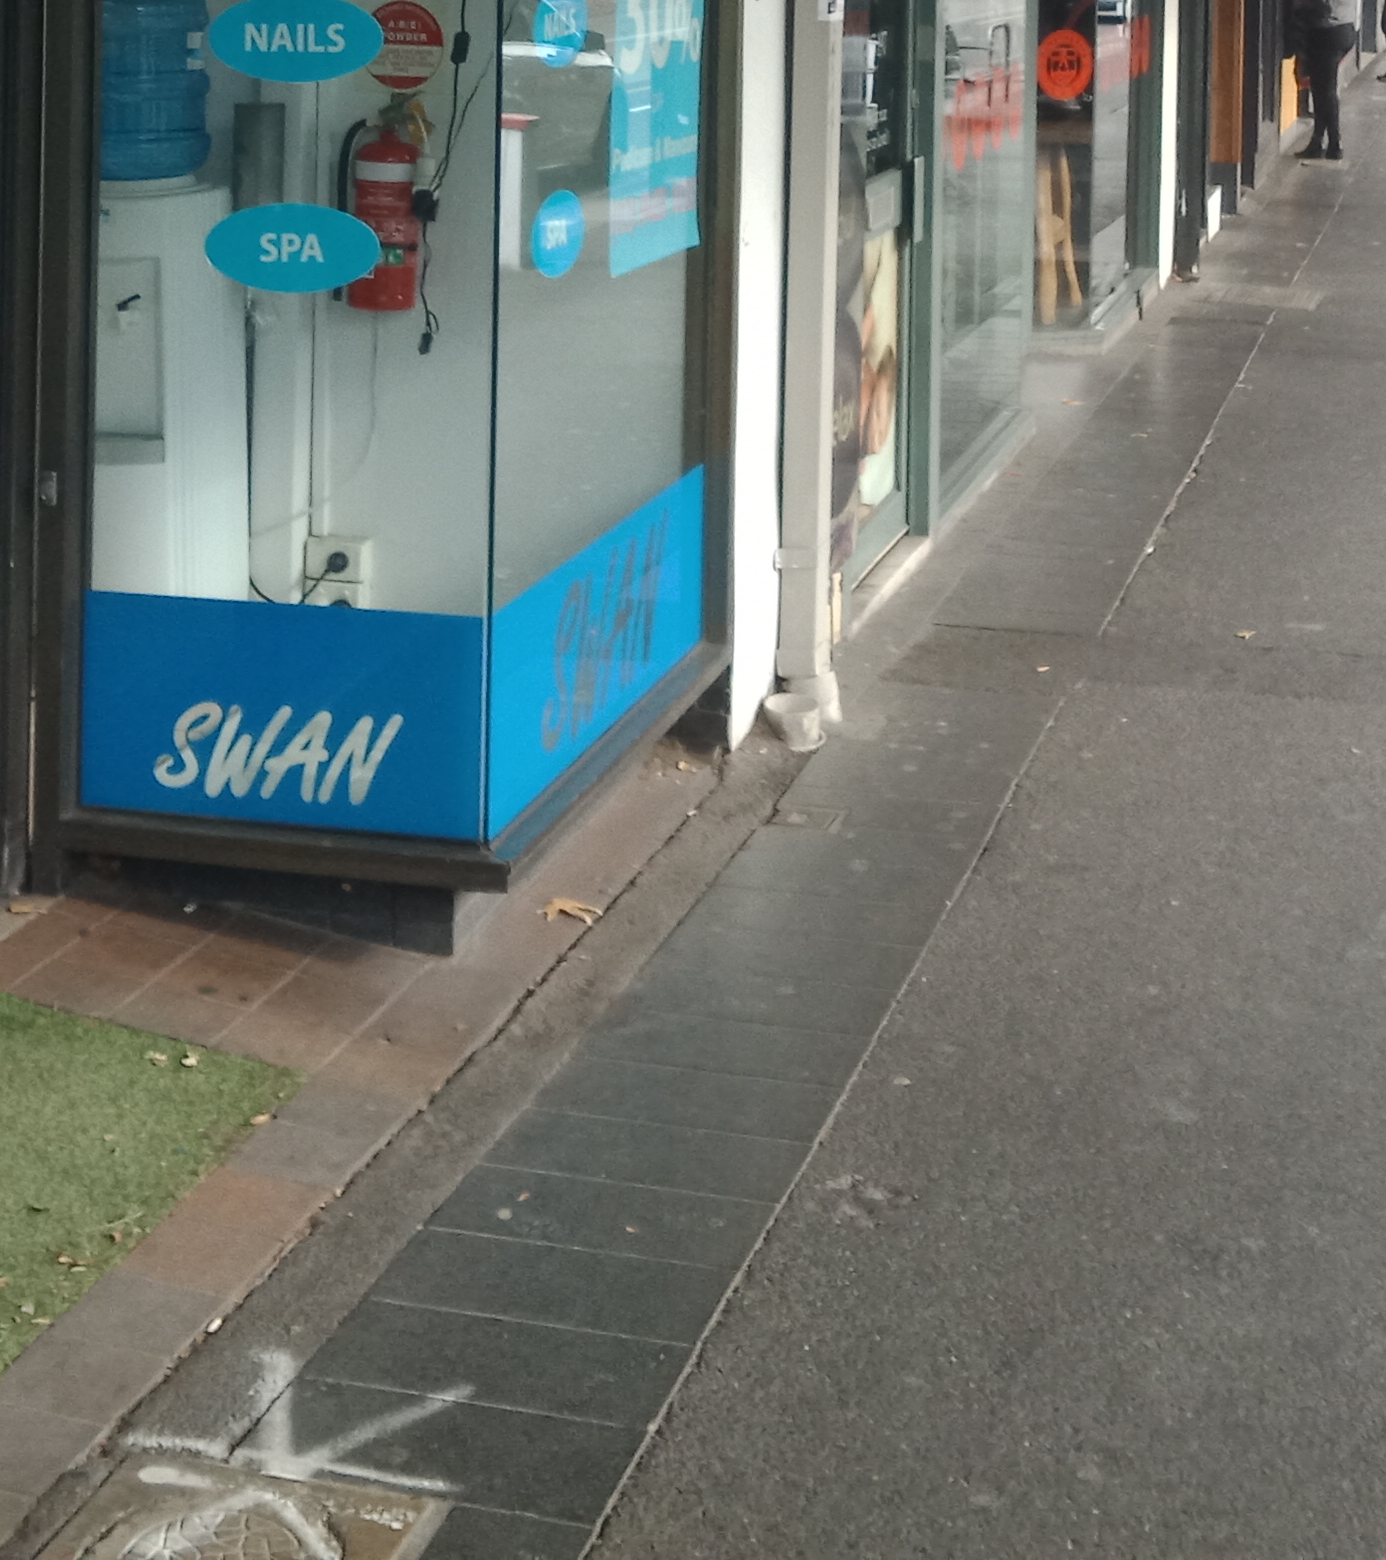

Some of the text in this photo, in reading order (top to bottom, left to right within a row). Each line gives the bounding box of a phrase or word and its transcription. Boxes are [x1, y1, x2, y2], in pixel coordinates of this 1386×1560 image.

[244, 23, 346, 54] NAILS
[383, 32, 427, 42] OWDER
[259, 233, 323, 264] SPA
[541, 507, 670, 753] SWAN
[153, 701, 403, 806] SWAN
